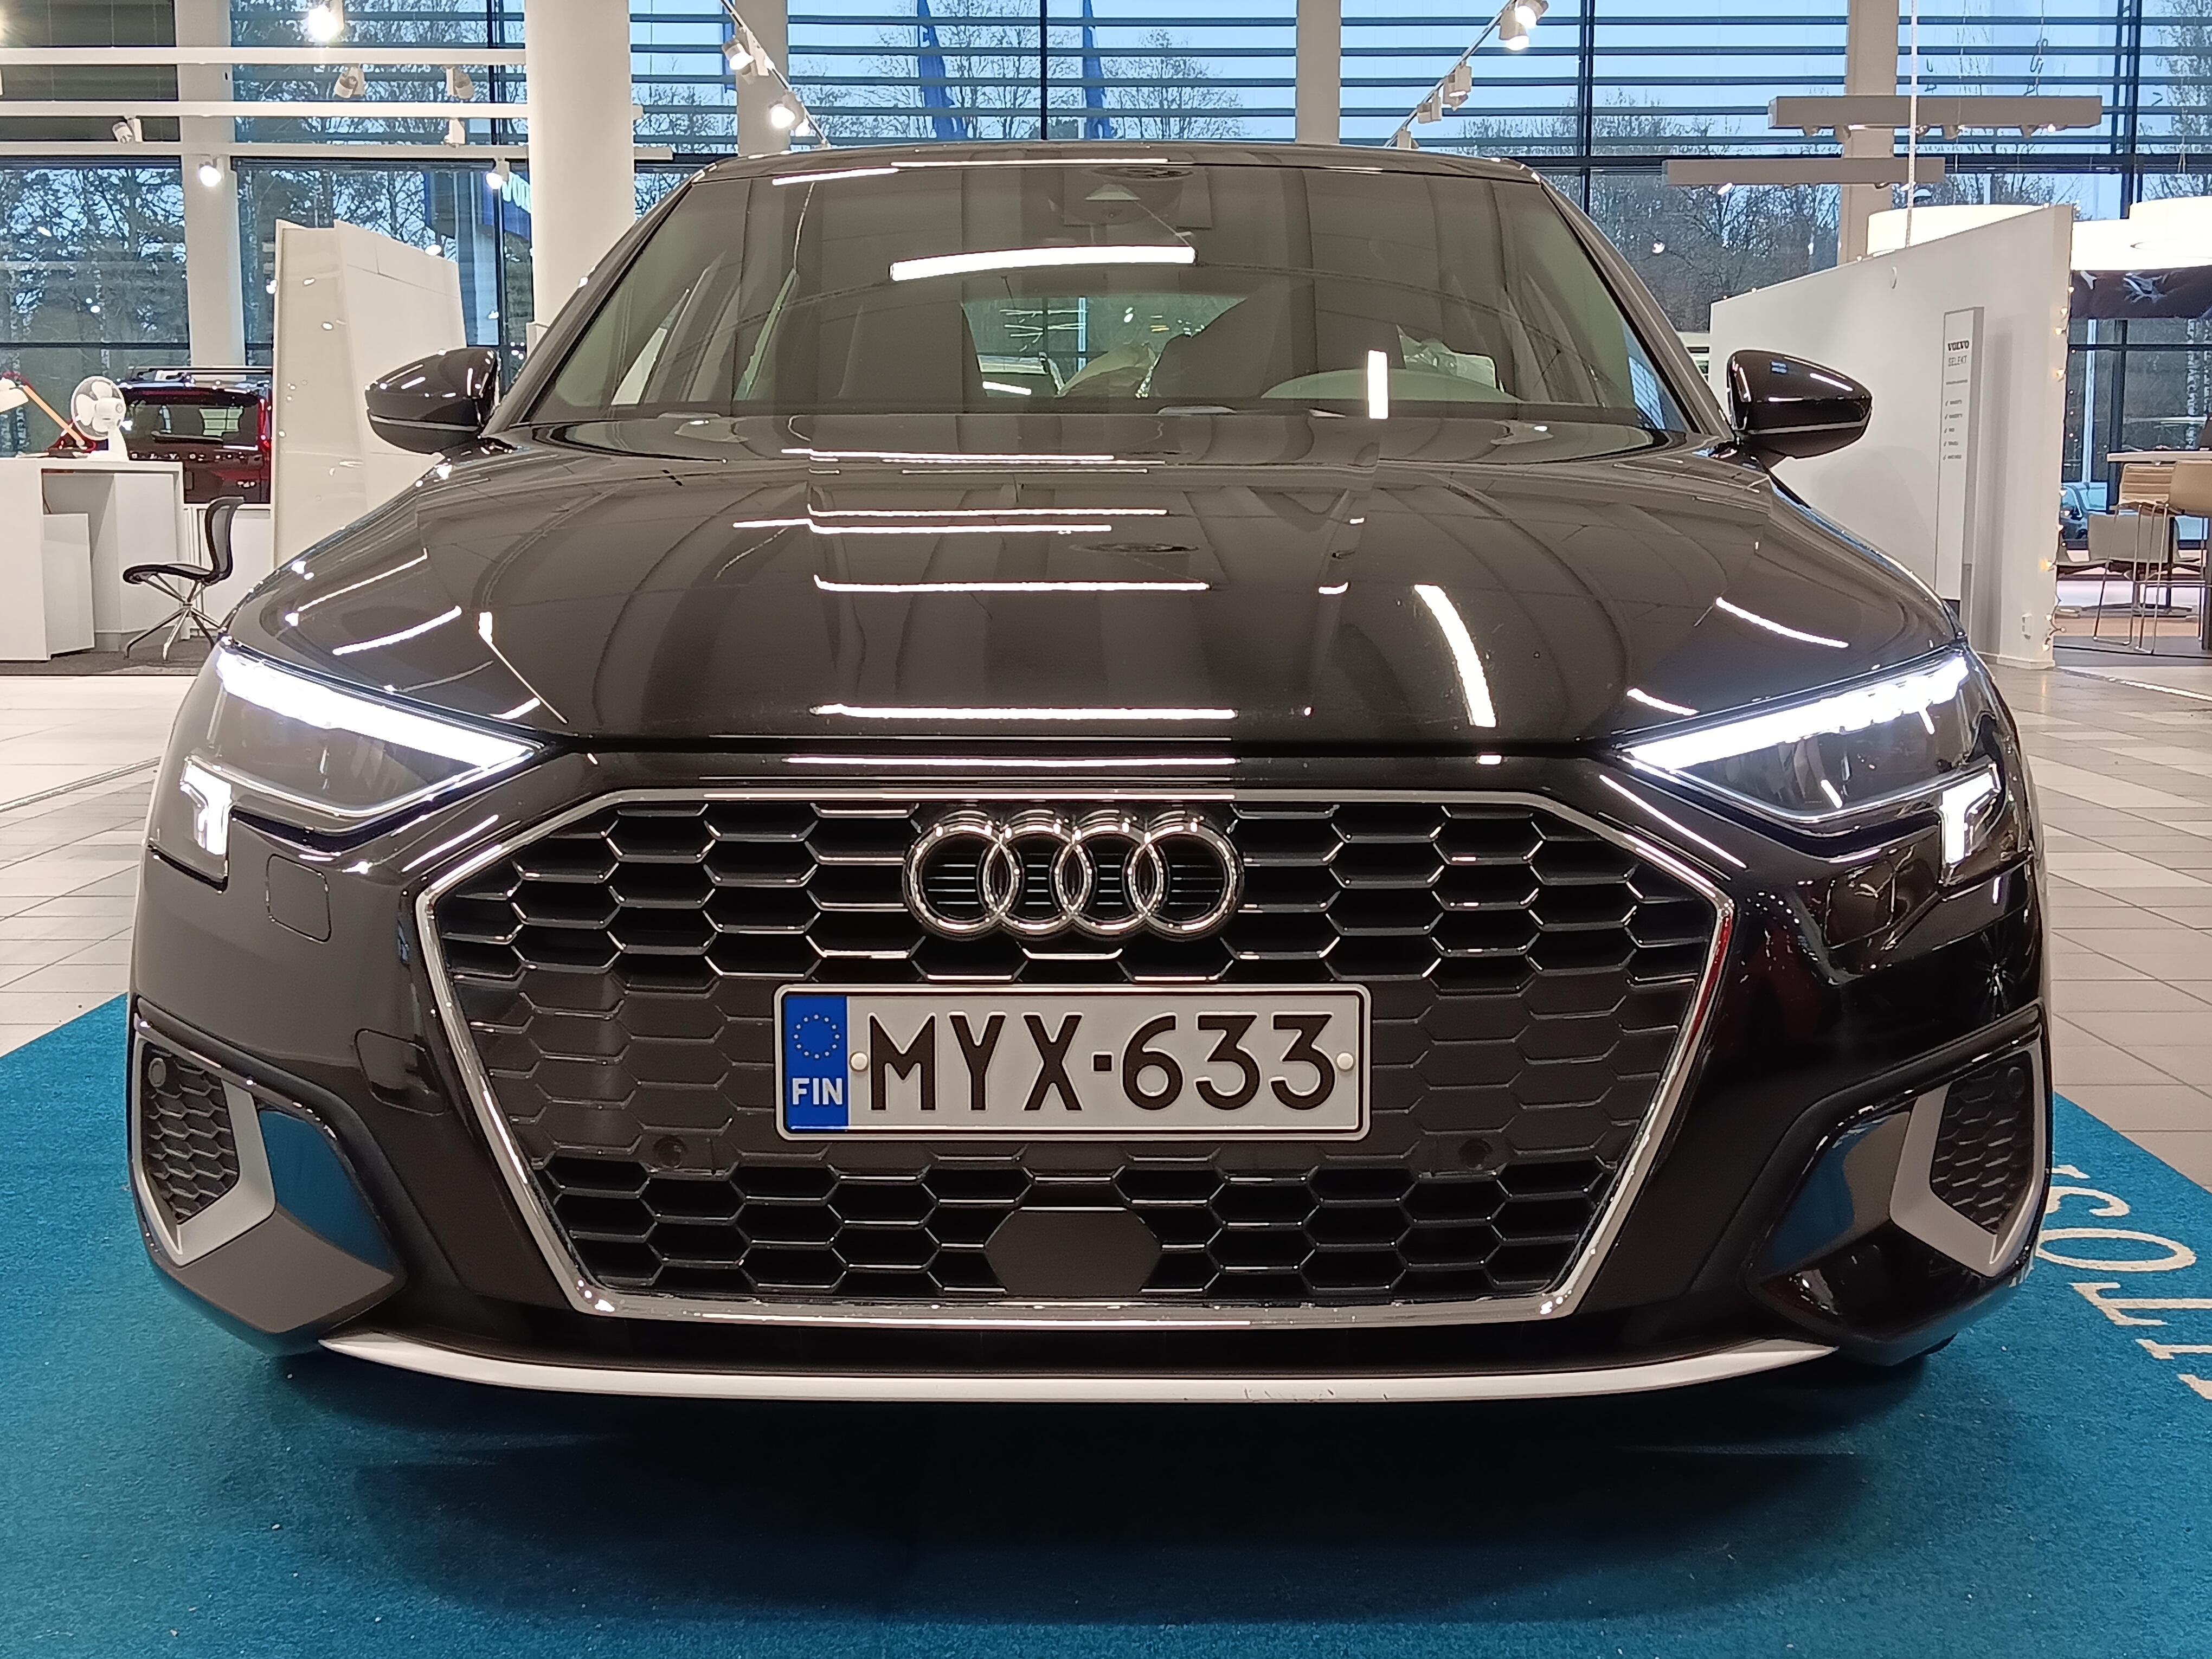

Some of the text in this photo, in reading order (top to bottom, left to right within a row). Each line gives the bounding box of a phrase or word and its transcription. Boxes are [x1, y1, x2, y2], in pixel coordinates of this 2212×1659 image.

[1947, 340, 1970, 351] VOLVO
[869, 1012, 1336, 1111] MYX-633
[792, 1077, 844, 1107] FIN
